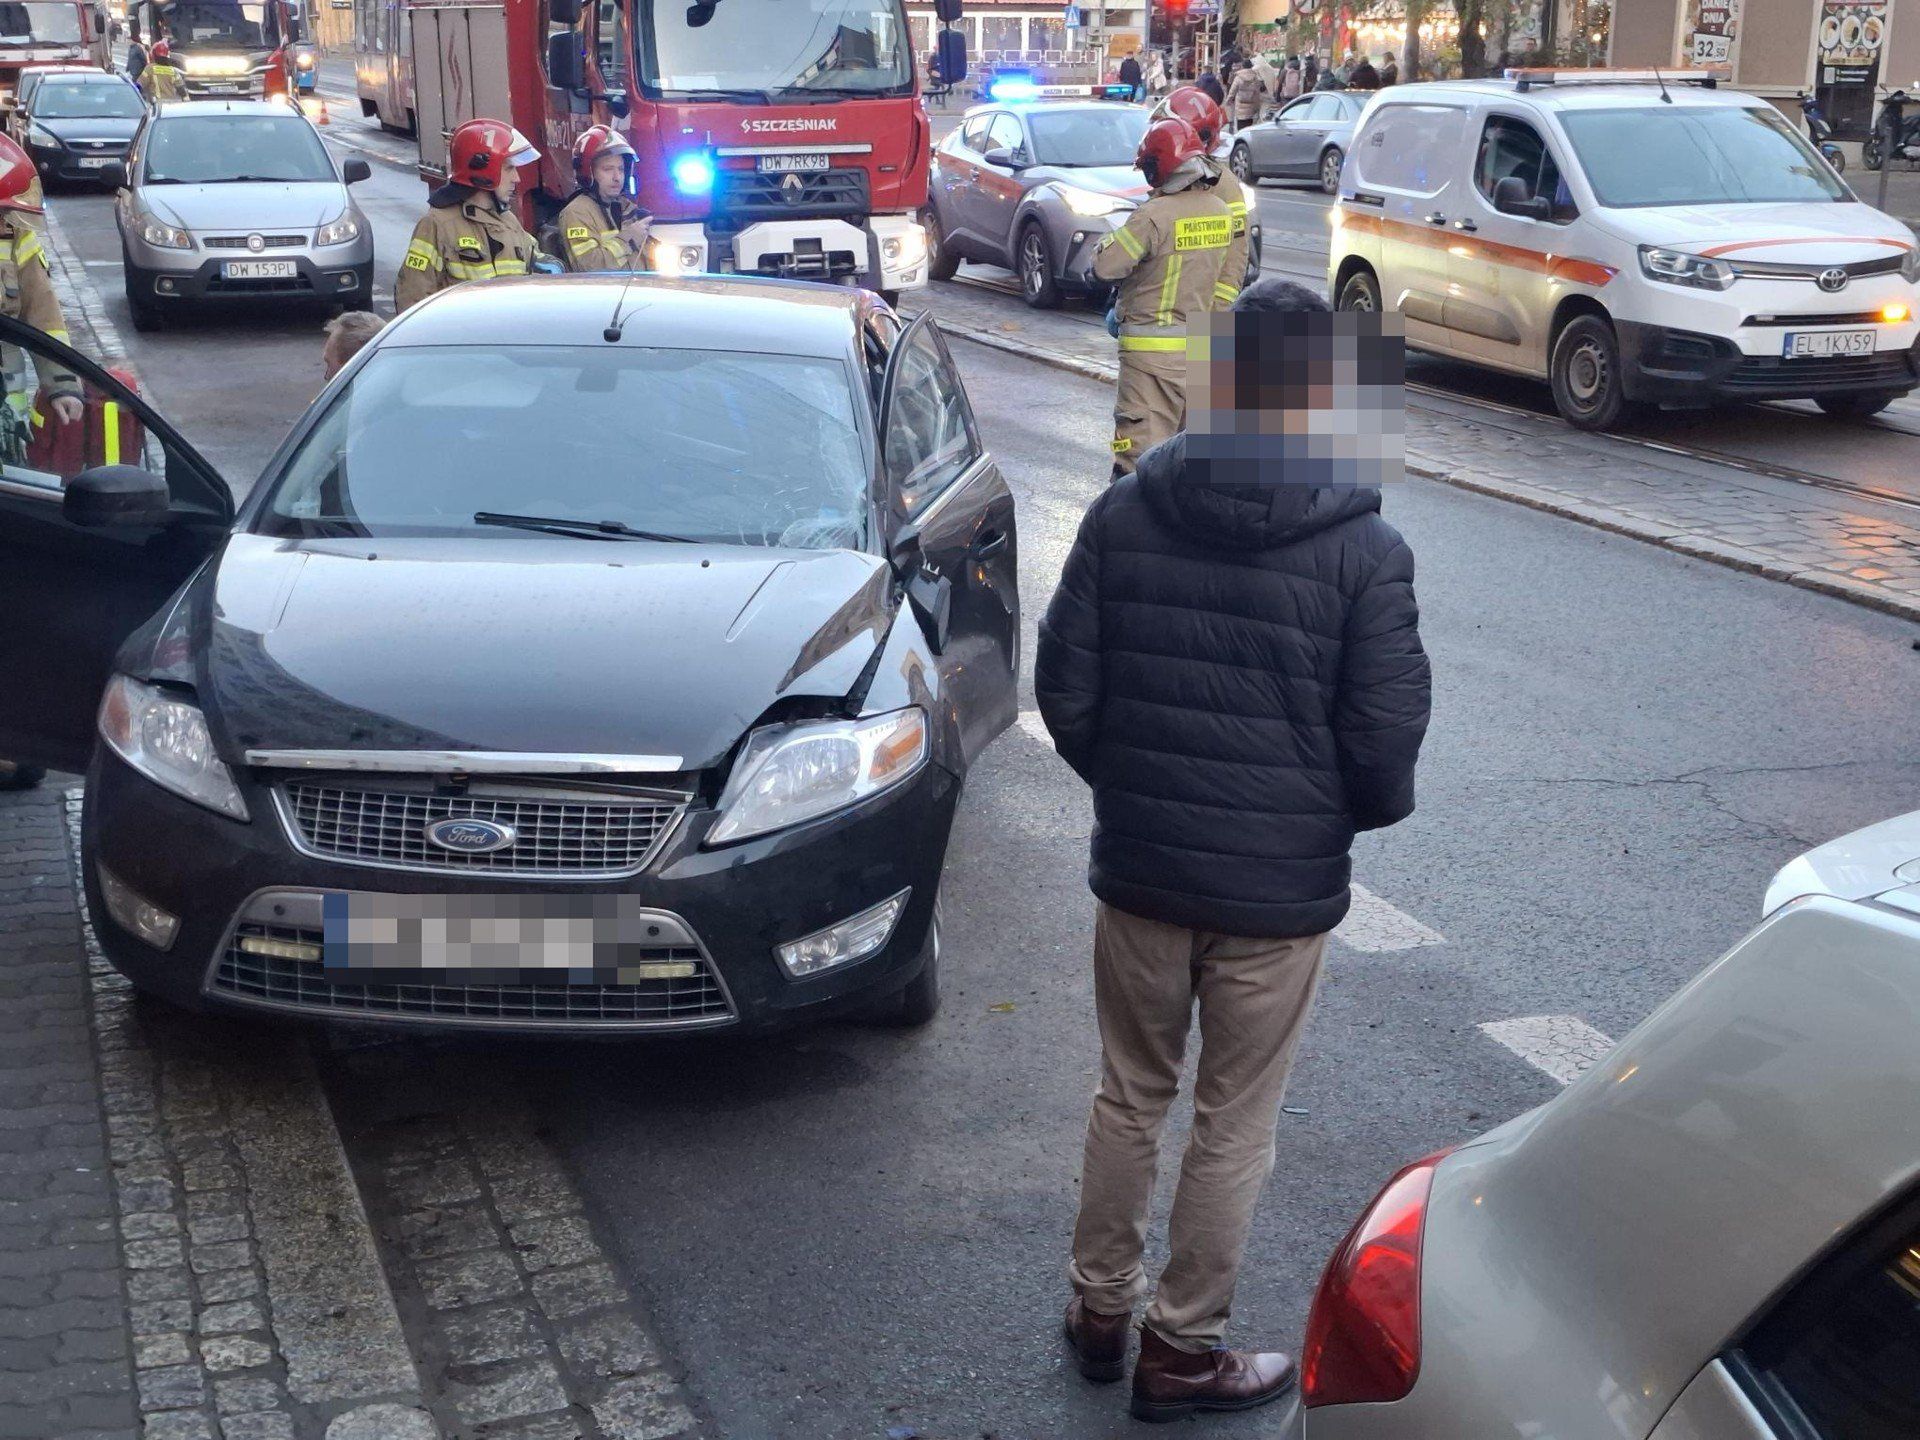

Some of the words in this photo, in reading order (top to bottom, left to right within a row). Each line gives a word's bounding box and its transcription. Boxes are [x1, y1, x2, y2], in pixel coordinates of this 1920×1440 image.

[1702, 12, 1725, 23] DNIA
[752, 117, 837, 133] SZCZĘŚNIAK
[765, 155, 781, 170] DW
[787, 154, 827, 168] 7RK98
[570, 229, 586, 237] PSP
[408, 256, 425, 268] PSP
[229, 264, 249, 276] DW
[255, 263, 295, 276] 153PL
[1796, 336, 1815, 353] EL
[1825, 334, 1872, 351] 1KX59
[447, 826, 488, 844] Ford
